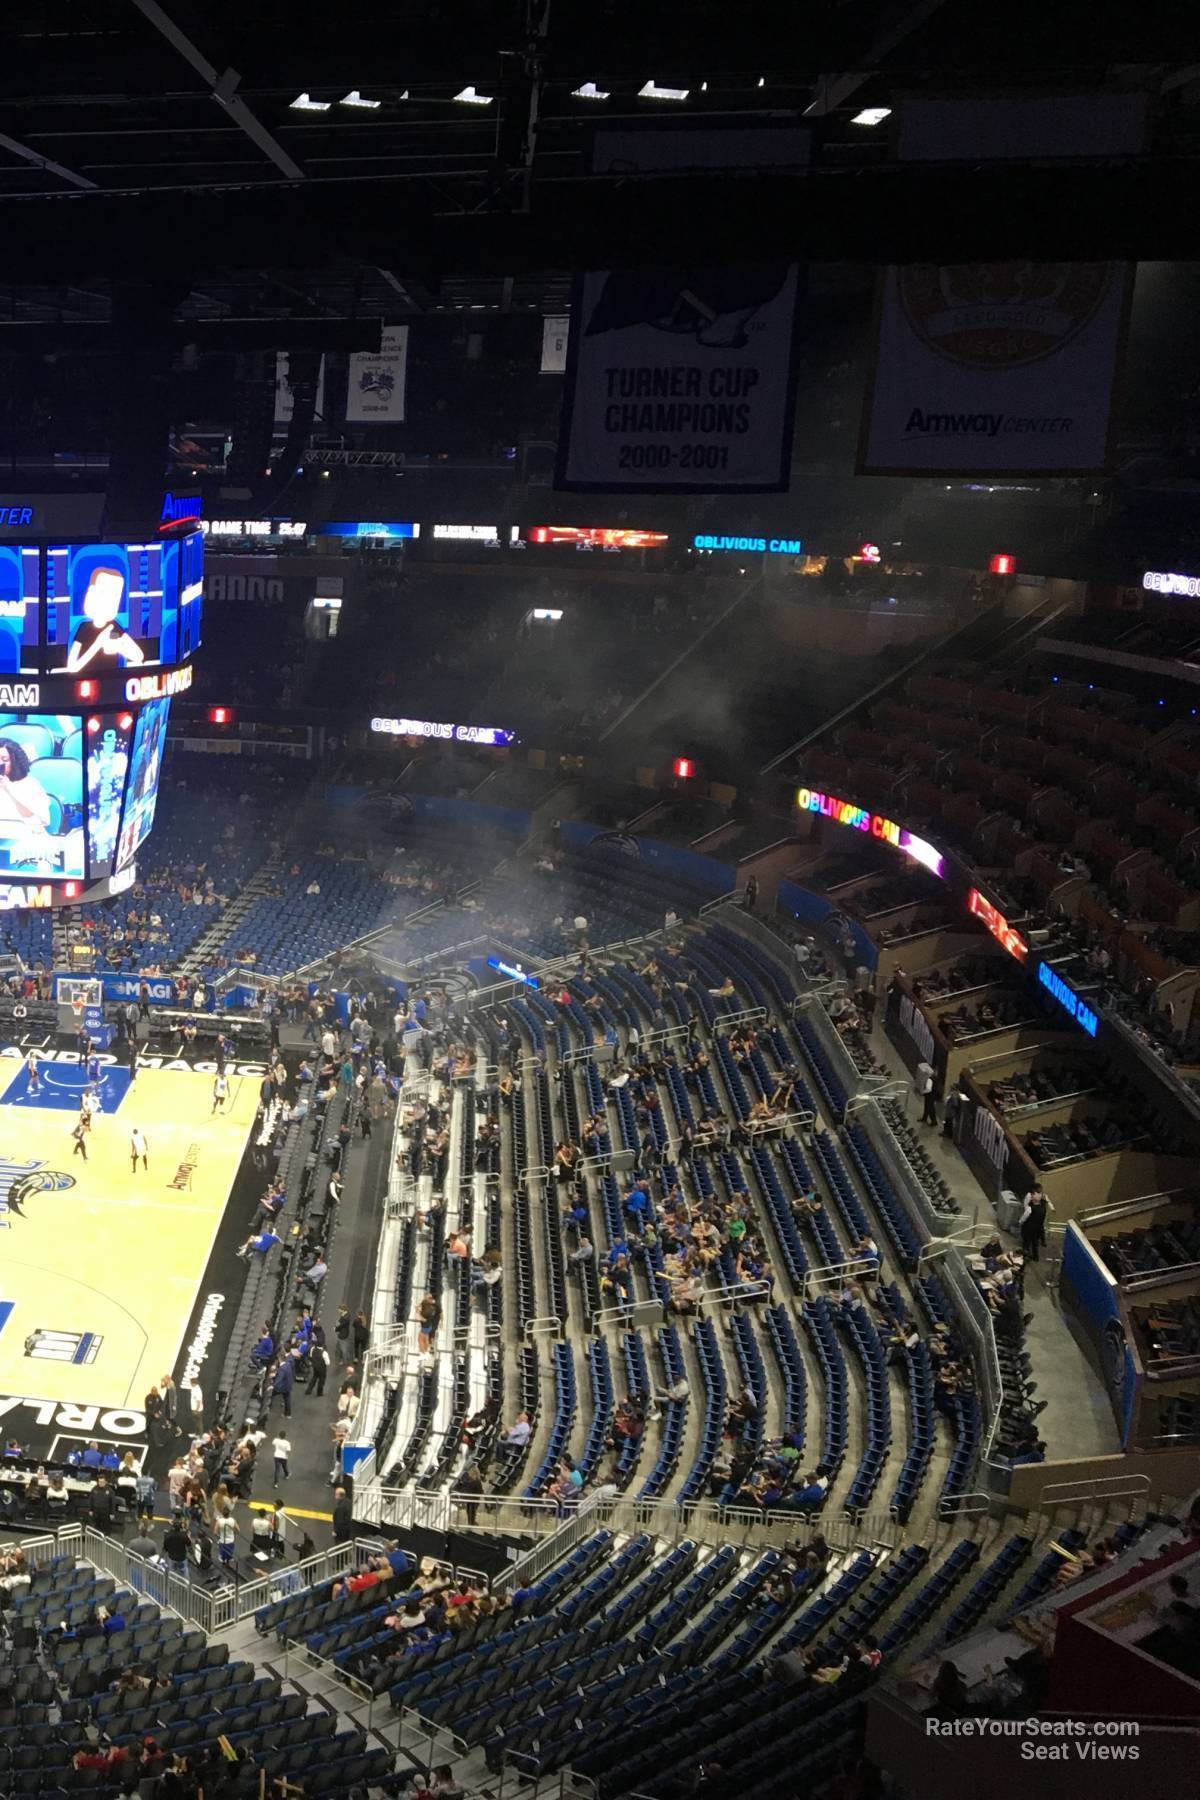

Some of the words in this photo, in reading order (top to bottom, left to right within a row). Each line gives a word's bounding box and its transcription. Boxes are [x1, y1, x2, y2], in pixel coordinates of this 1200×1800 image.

[604, 366, 701, 398] TURNER
[708, 366, 761, 398] CUP
[604, 402, 751, 434] CHAMPIONS
[904, 407, 1003, 437] Amway
[1002, 416, 1074, 434] CENTER
[618, 444, 729, 469] 2000-2001
[694, 535, 767, 551] OBLIVIOUS
[769, 538, 801, 554] CAM
[798, 787, 870, 833] OBLIVIOUS
[871, 812, 901, 847] CAM
[1038, 960, 1078, 1016] OBLIVIOUS
[1074, 998, 1099, 1038] CAM
[134, 1056, 267, 1077] MAGIC
[165, 1162, 198, 1191] Amway
